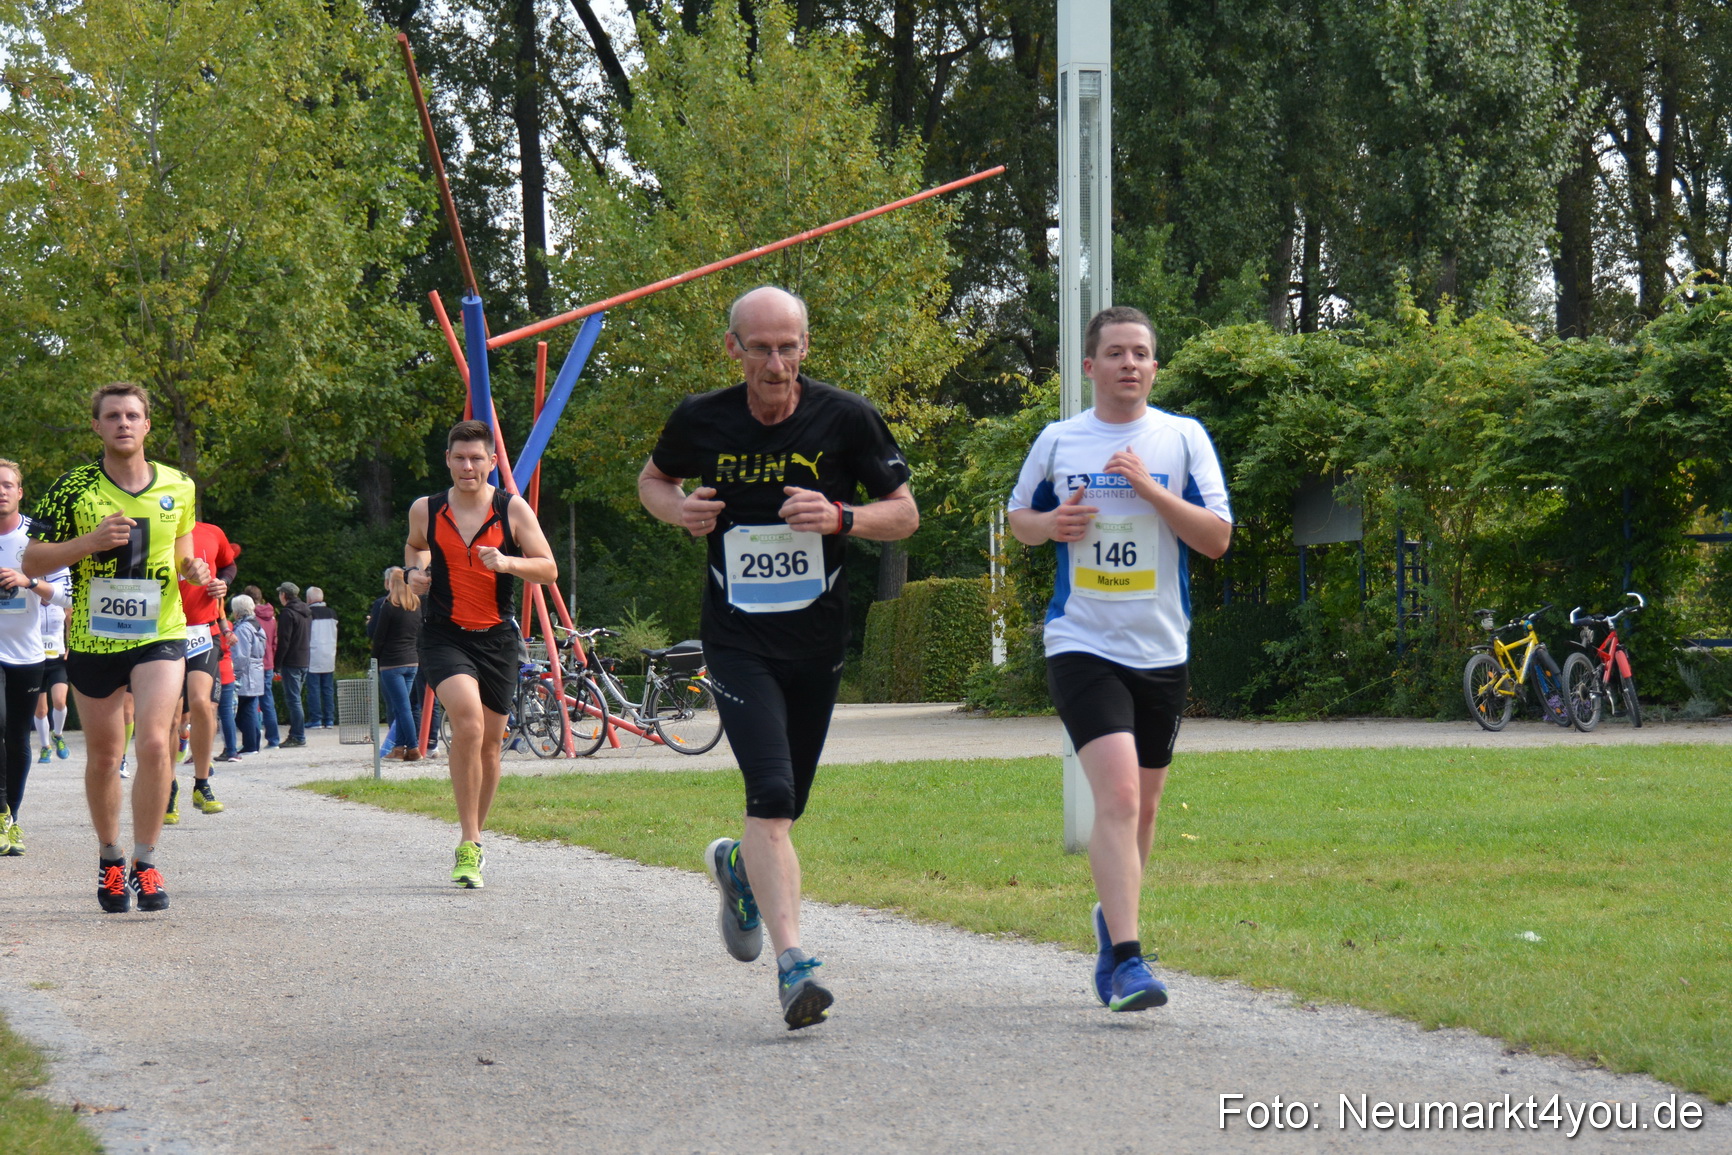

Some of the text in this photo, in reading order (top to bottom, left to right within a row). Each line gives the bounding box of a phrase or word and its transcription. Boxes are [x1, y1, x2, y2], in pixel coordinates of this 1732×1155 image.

[716, 453, 787, 482] RUN
[740, 550, 809, 578] 2936
[1093, 540, 1137, 567] 146
[1097, 574, 1130, 586] Markus
[100, 597, 147, 617] 2661
[117, 621, 132, 630] Max
